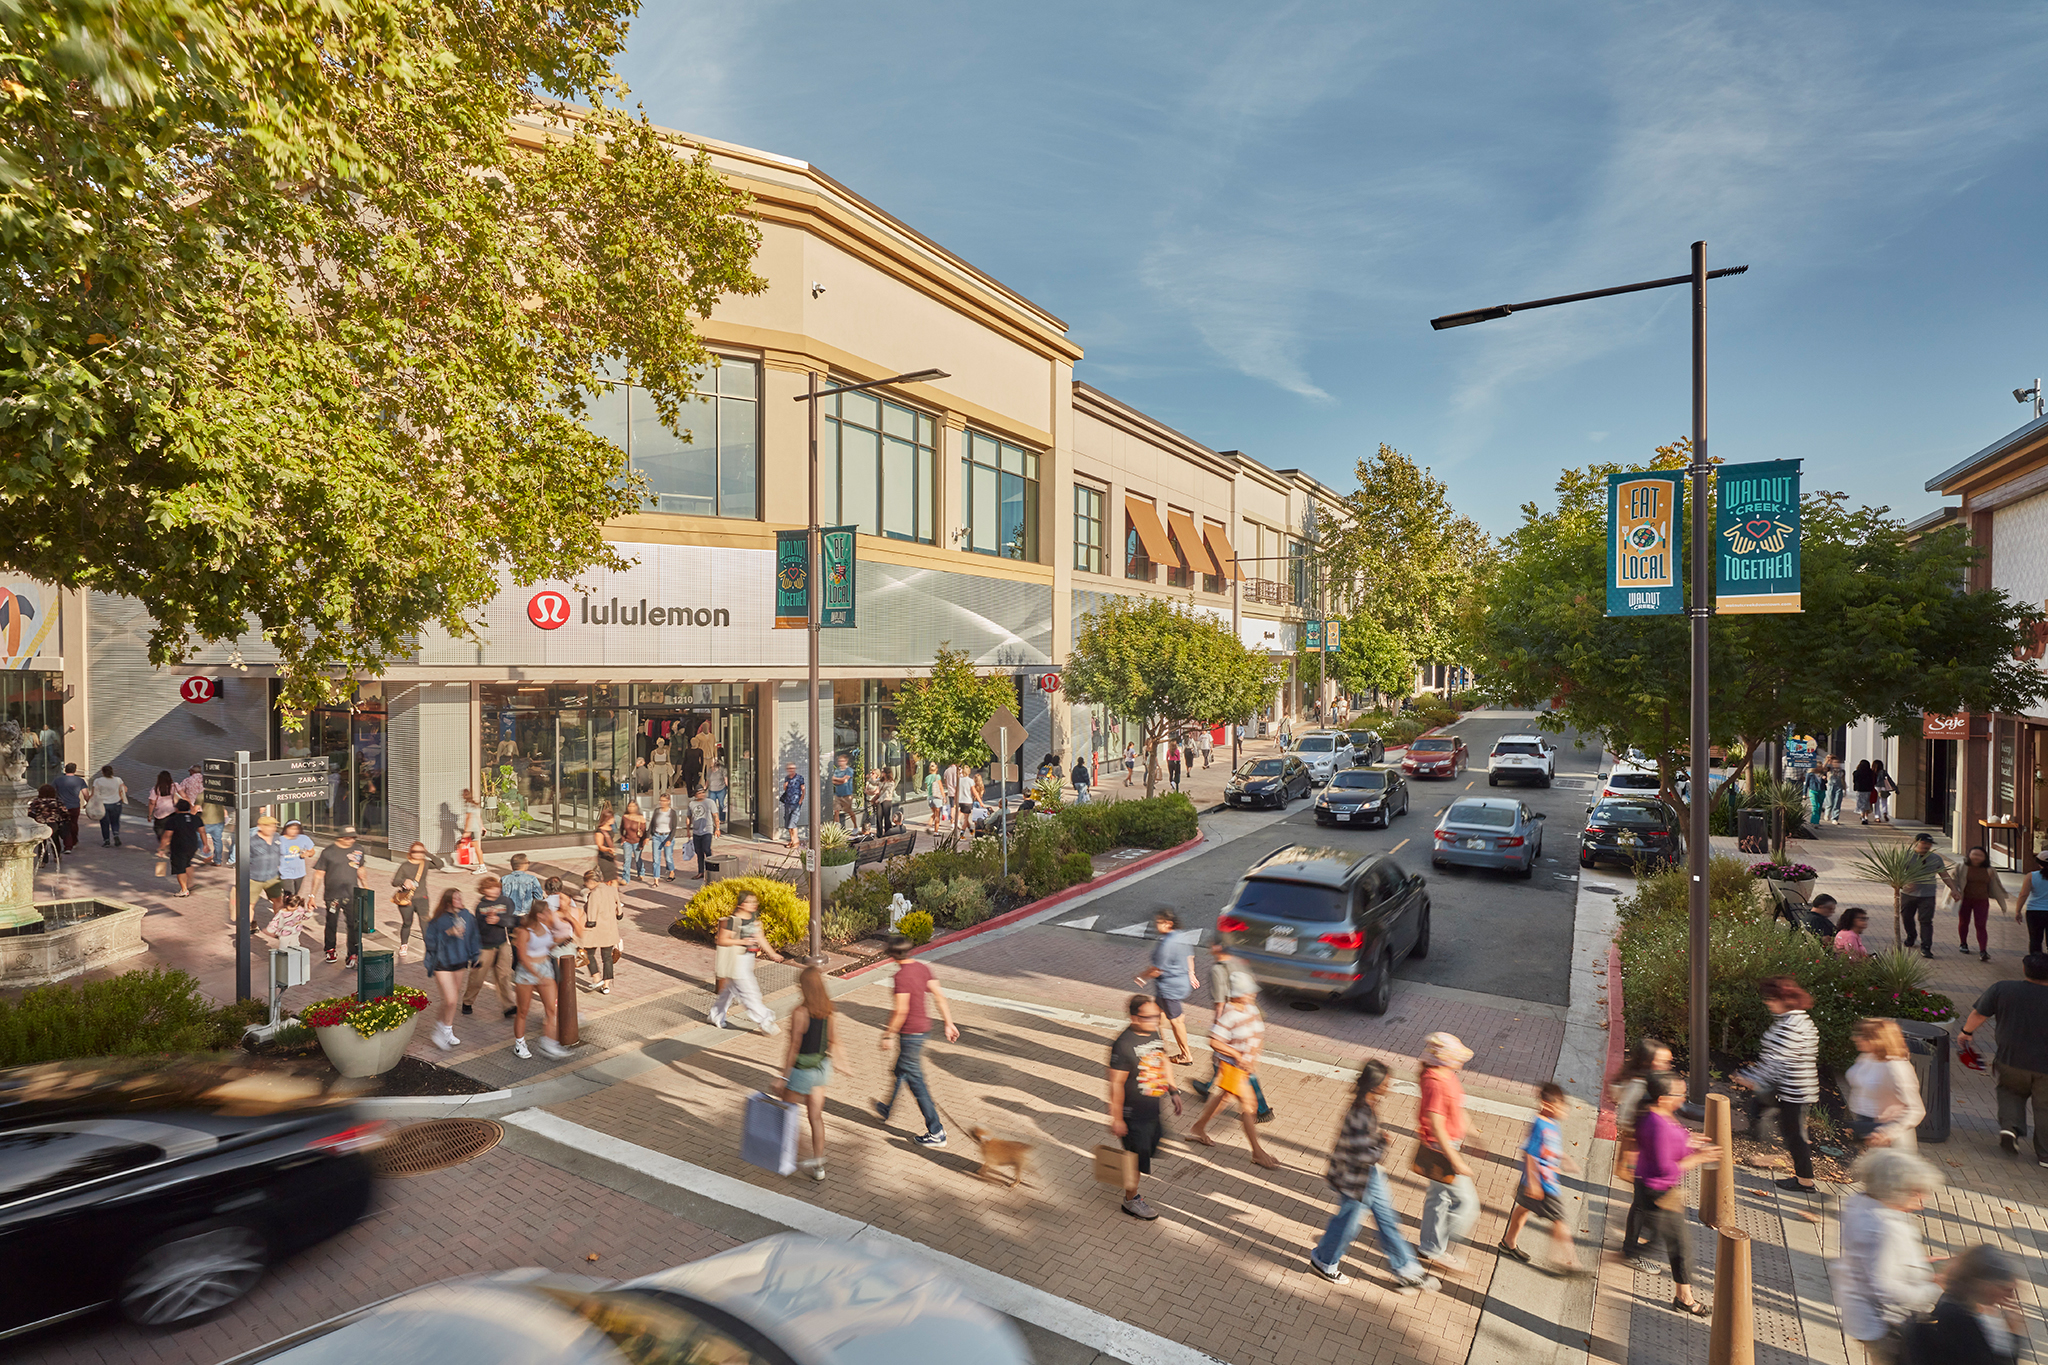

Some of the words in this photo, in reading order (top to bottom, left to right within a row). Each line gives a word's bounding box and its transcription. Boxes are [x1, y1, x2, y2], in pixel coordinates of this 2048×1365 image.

[1726, 477, 1792, 510] WALNUT
[1631, 486, 1660, 520] EAT
[1736, 503, 1780, 515] CREEK
[779, 540, 806, 560] WALNUT
[834, 538, 844, 559] BE
[784, 556, 803, 564] CREEK
[1622, 553, 1667, 580] LOCAL
[1724, 552, 1793, 581] TOGETHER
[778, 589, 807, 606] TOGETHER
[829, 584, 849, 604] LOCAL
[1628, 592, 1660, 607] WALNUT
[581, 597, 730, 627] lululemon
[1634, 603, 1656, 611] CREEK
[672, 695, 693, 704] 1210
[1928, 716, 1965, 731] Saje
[290, 761, 317, 769] MACY'S
[298, 776, 317, 784] ZARA
[276, 790, 317, 801] RESTROOMS
